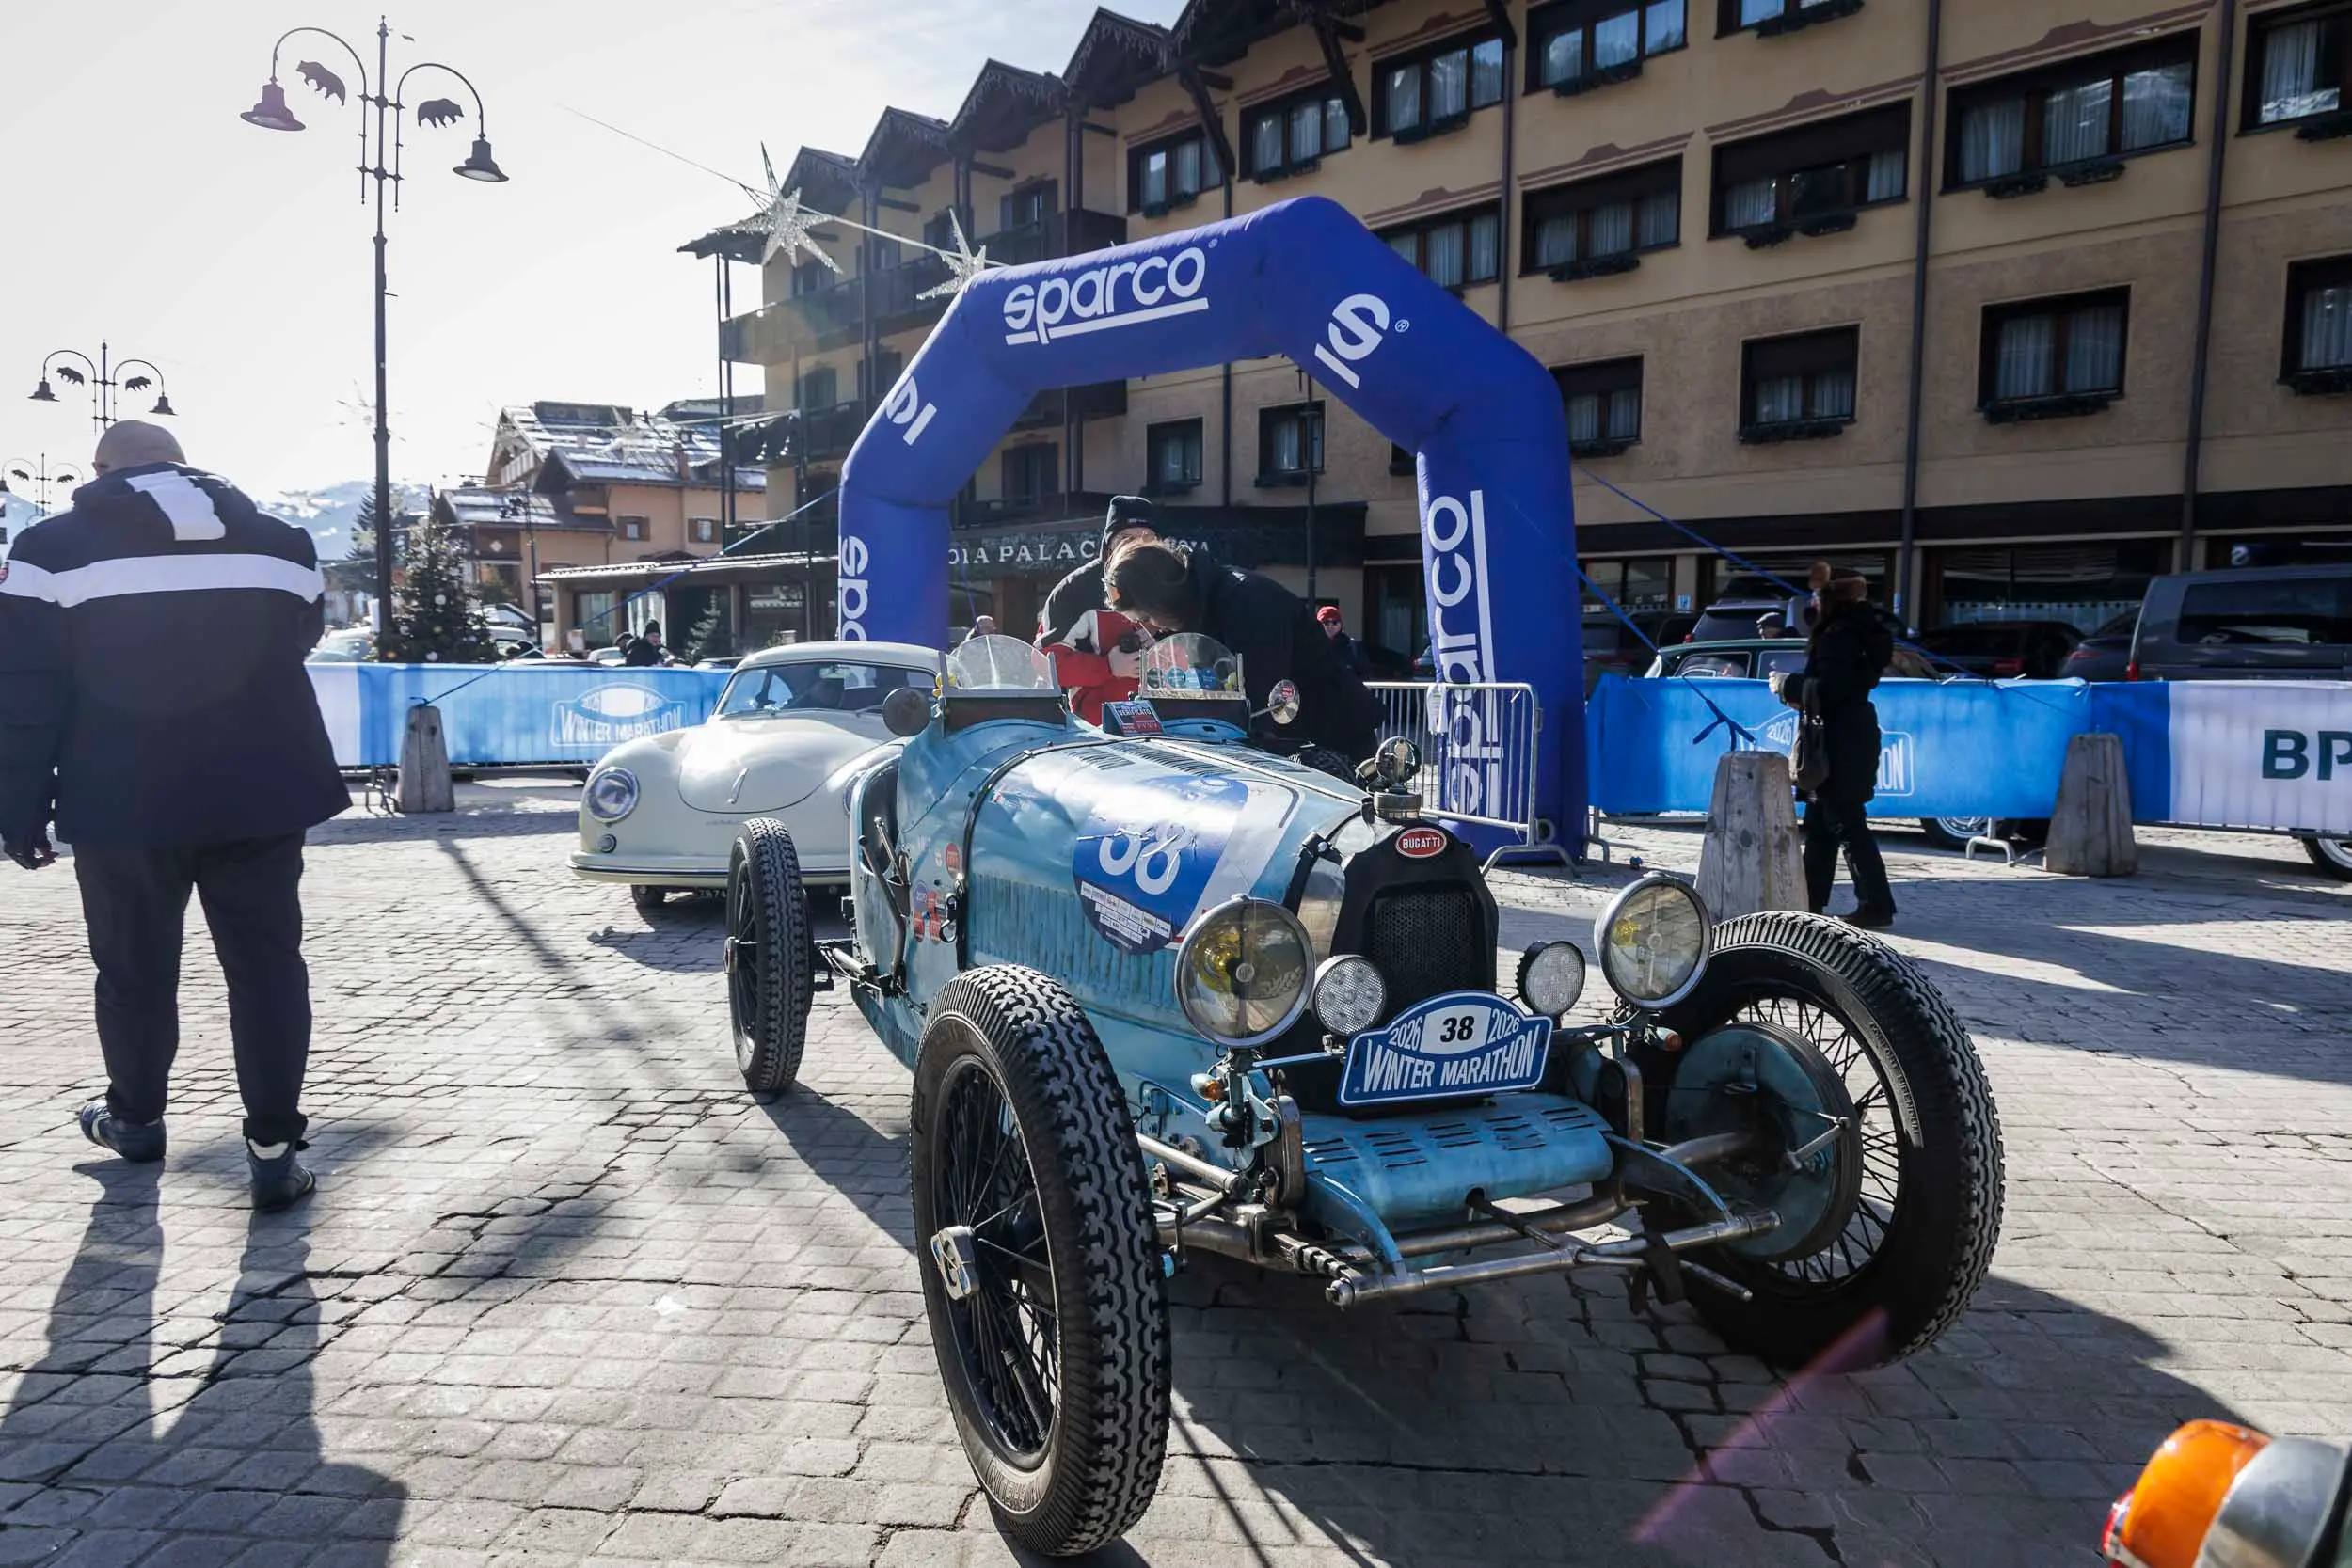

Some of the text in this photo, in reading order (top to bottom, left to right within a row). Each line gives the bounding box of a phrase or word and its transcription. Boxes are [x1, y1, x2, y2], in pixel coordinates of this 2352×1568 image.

[1003, 246, 1208, 345] sparco
[998, 540, 1096, 562] PALAC
[1427, 495, 1504, 816] sparco
[560, 705, 611, 743] WINTER
[1766, 717, 1793, 746] 2026
[1402, 837, 1441, 849] BUGATTI
[1388, 1008, 1520, 1052] 2026 38 2026
[1363, 1023, 1541, 1093] WINTER MARATHON
